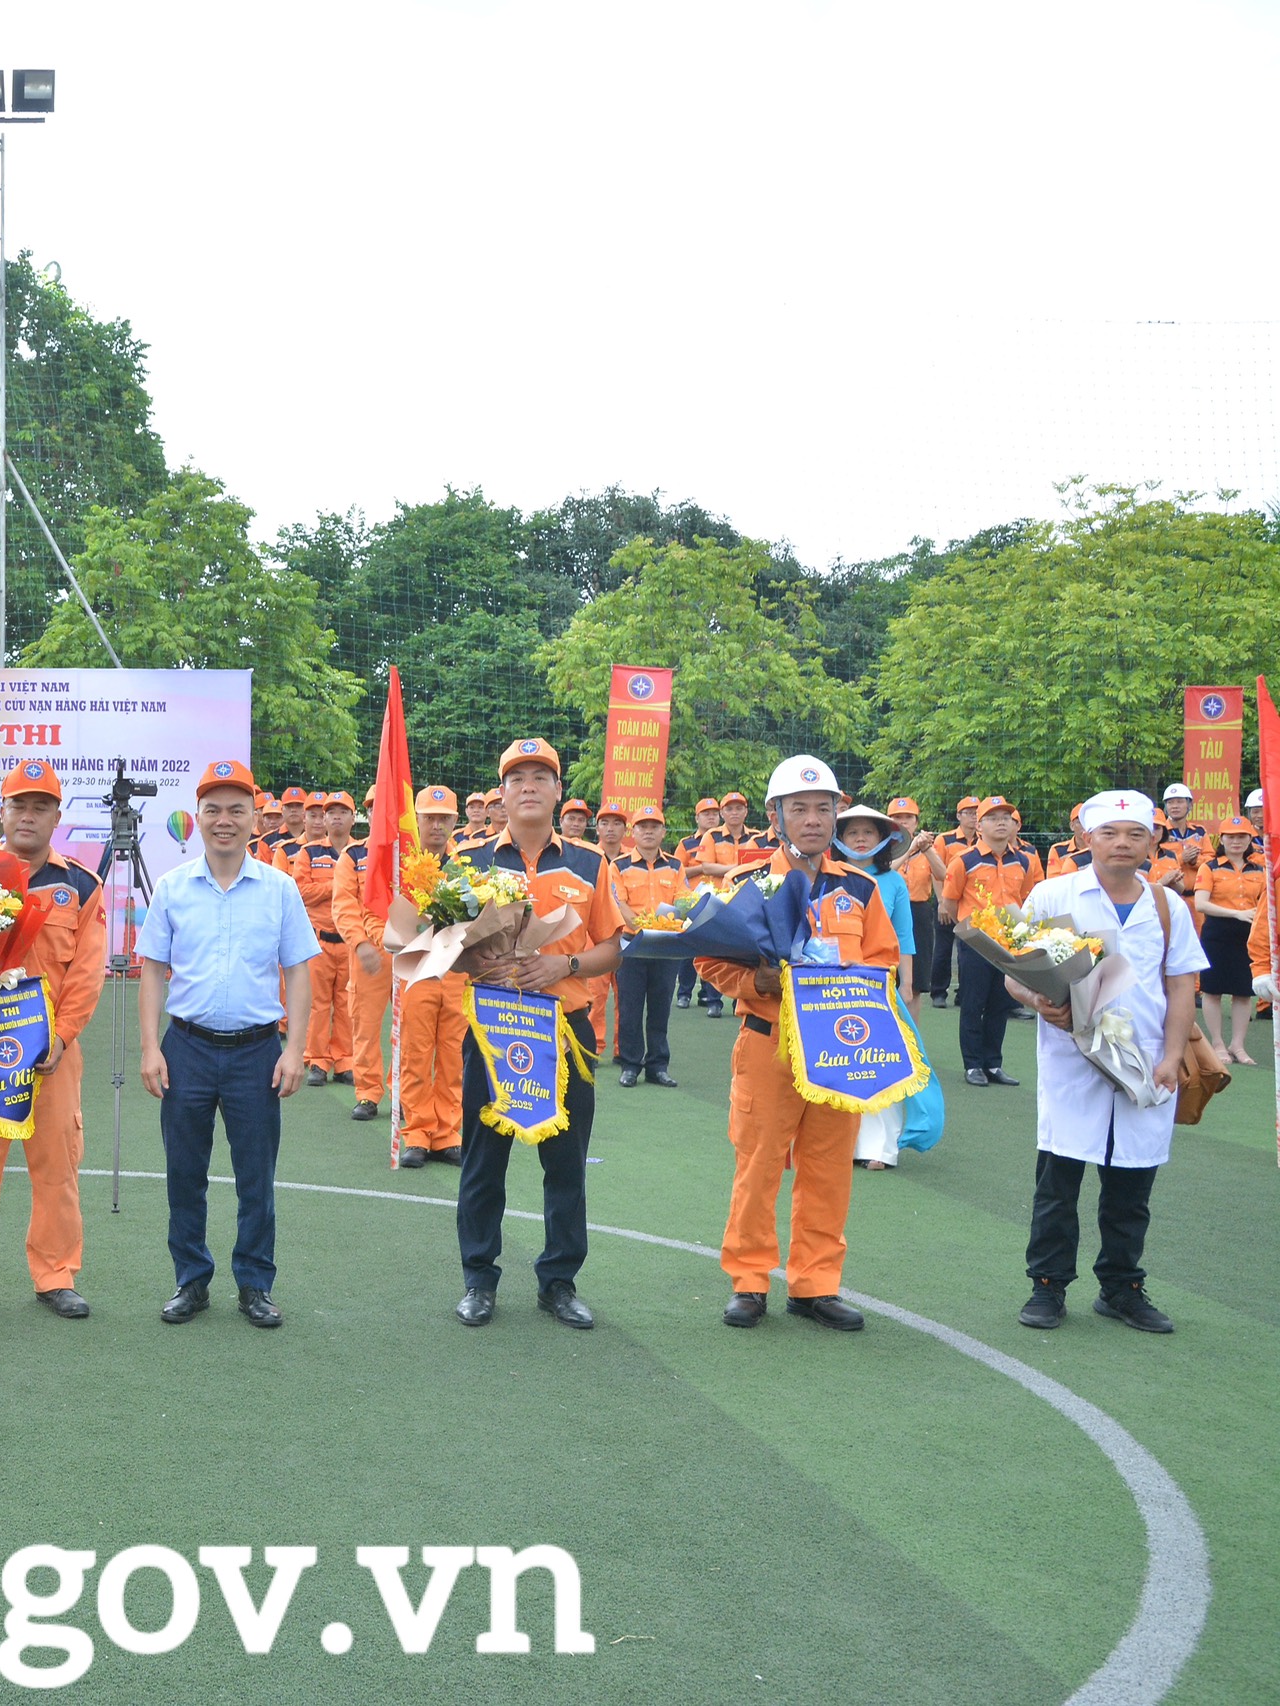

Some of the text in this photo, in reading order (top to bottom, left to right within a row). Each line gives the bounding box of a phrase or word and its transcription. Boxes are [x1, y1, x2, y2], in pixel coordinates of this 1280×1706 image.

[9, 678, 37, 695] VIỆT
[41, 682, 70, 693] NAM
[4, 697, 26, 711] CỨU
[29, 700, 52, 713] NẠN
[55, 698, 86, 712] HÀNG
[90, 698, 110, 712] HẢI
[113, 698, 138, 715] VIỆT
[141, 701, 167, 712] NAM
[0, 723, 62, 746] THI
[617, 717, 660, 738] TOÀN DÂN
[613, 744, 659, 766] RÈN LUYỆN
[1200, 737, 1224, 759] TÀU
[72, 755, 104, 772] HÀNG
[131, 756, 158, 772] NĂM
[162, 759, 190, 773] 2022
[73, 778, 95, 786] 29-30
[160, 778, 180, 787] 2022
[614, 767, 655, 788] THÂN THỂ
[1187, 768, 1234, 792] LÀ NHÀ,
[1217, 797, 1235, 820] CẢ
[822, 986, 869, 1000] HỘI THI
[2, 1006, 20, 1017] THI
[498, 1012, 535, 1027] HỘI THI
[814, 1047, 902, 1068] Lưu Niệm
[846, 1070, 877, 1081] 2022
[4, 1091, 30, 1106] 2022
[518, 1077, 550, 1102] Niệm
[511, 1099, 533, 1111] 2022
